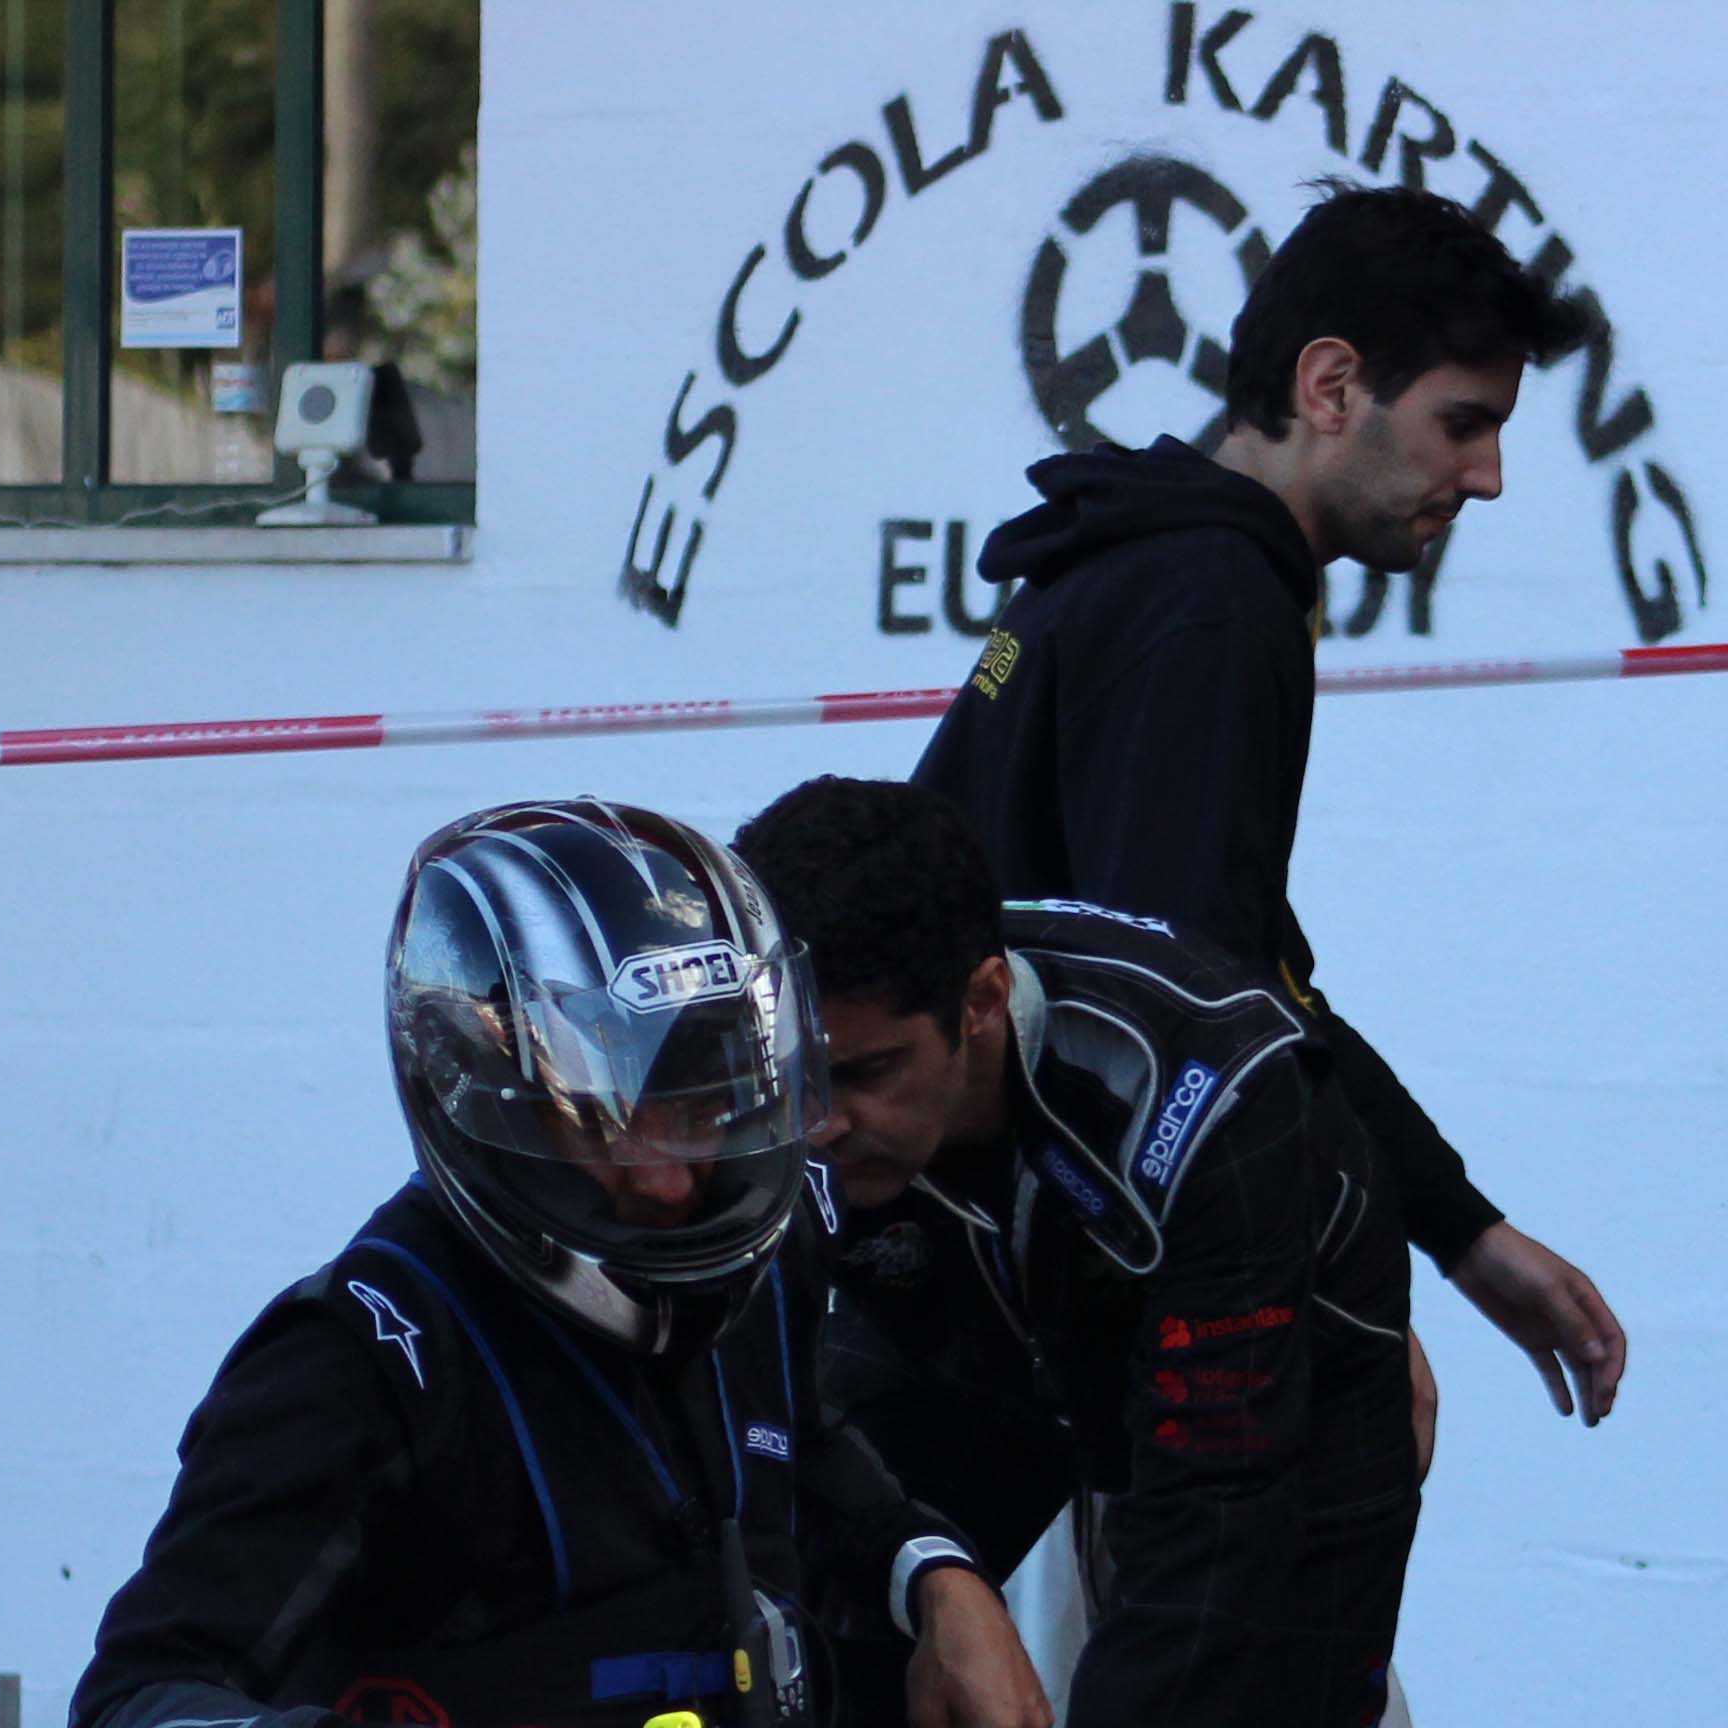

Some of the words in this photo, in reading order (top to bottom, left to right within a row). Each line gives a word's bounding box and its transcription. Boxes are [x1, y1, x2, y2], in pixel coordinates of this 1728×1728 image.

[616, 24, 1064, 634] ESCOLA
[632, 951, 738, 1001] SHOEI
[1142, 1068, 1213, 1184] sparco
